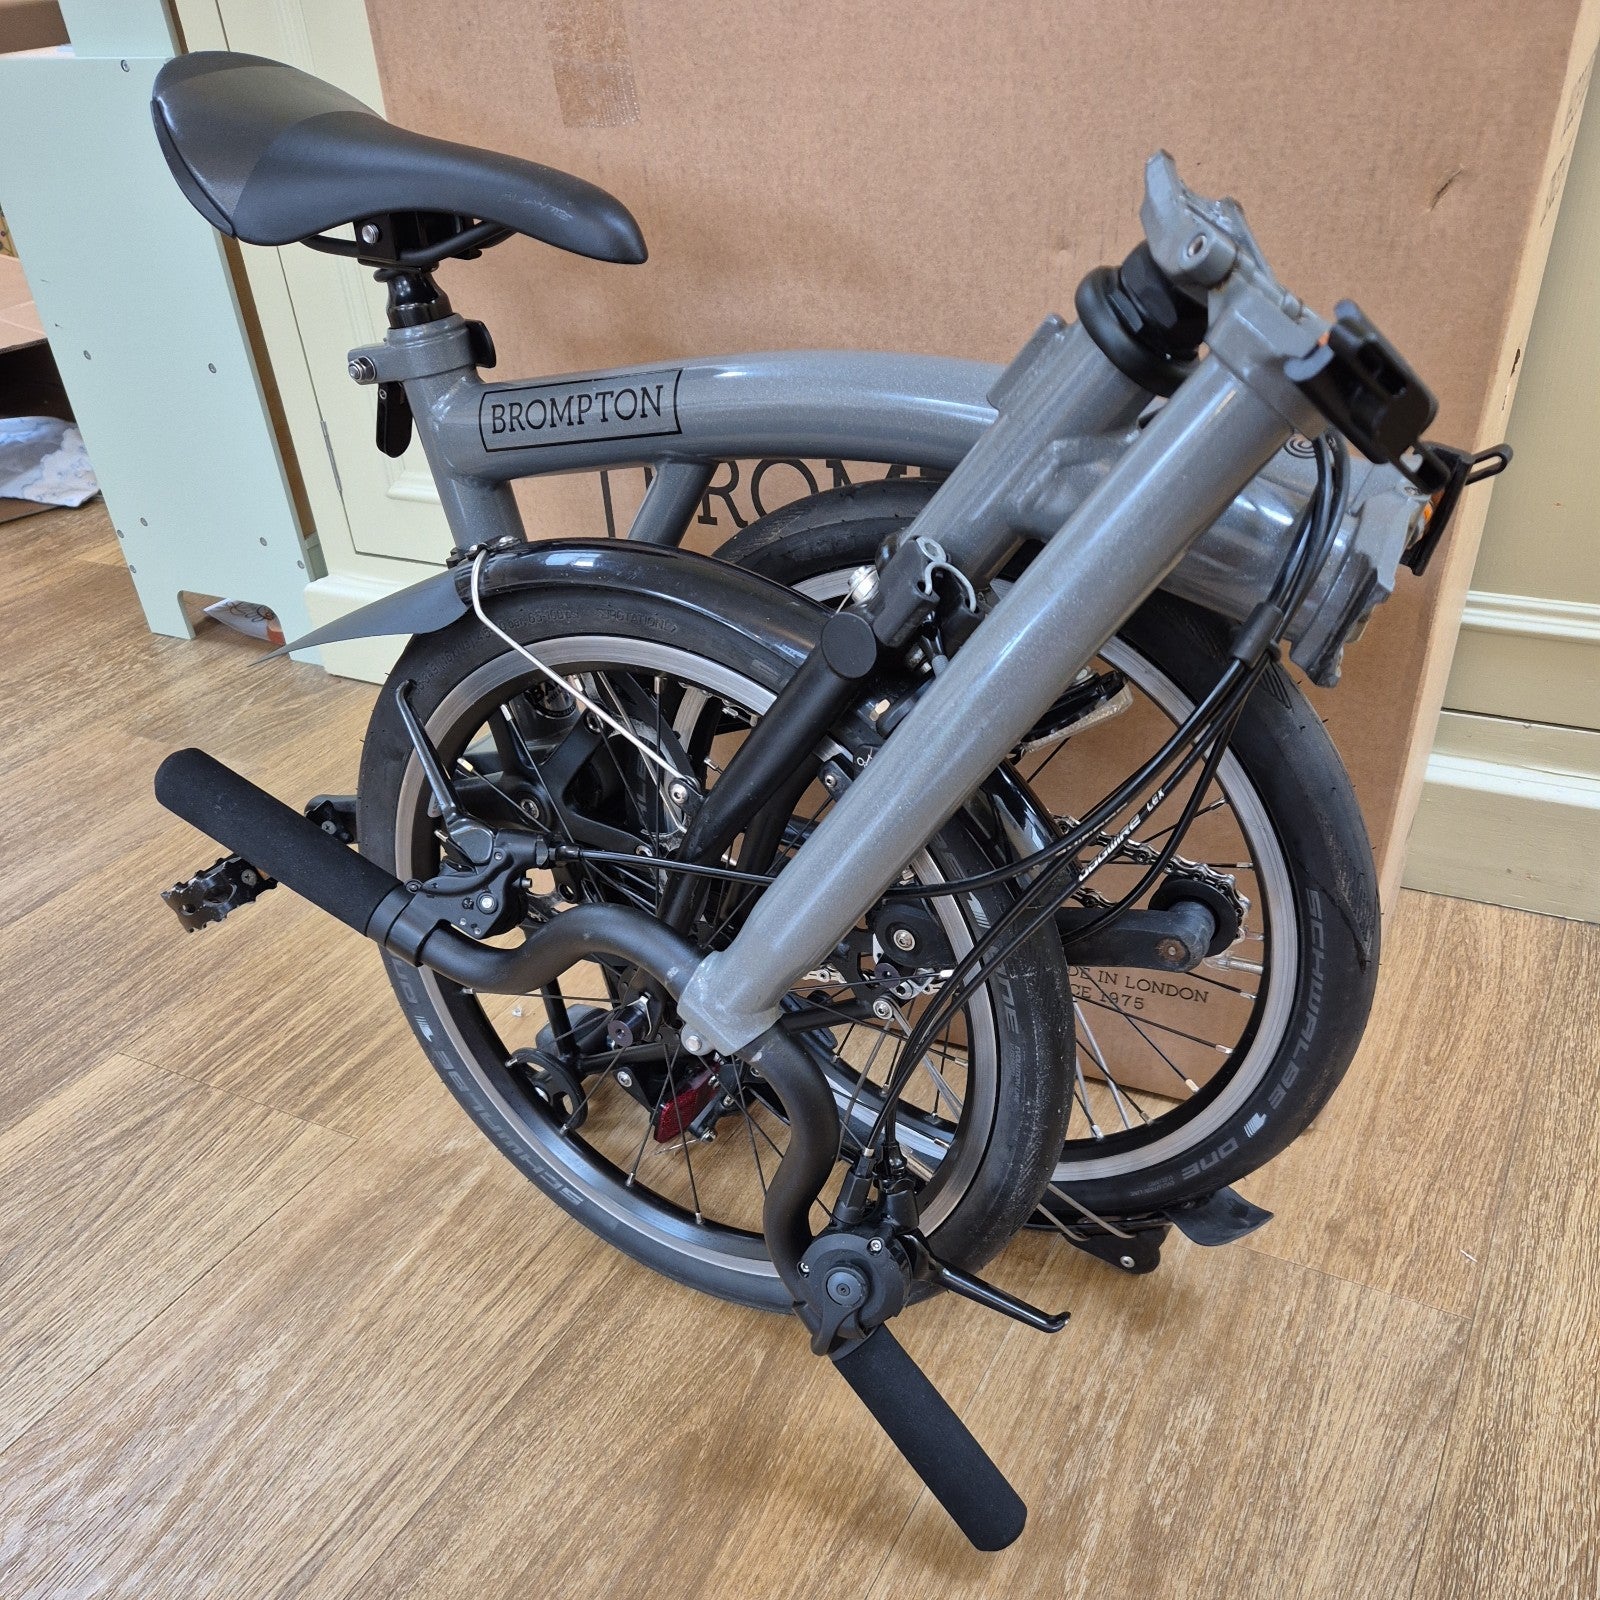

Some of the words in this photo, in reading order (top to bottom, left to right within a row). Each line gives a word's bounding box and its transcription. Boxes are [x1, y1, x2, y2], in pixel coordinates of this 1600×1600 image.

[491, 385, 664, 434] BROMPTON
[1147, 788, 1165, 812] LEX
[1098, 970, 1118, 985] IN
[1125, 976, 1209, 1003] LONDON
[1100, 991, 1144, 1009] 1975
[1267, 887, 1326, 1110] SCHWALBE
[432, 1050, 584, 1206] SCHWALBE
[1181, 1136, 1240, 1180] ONE
